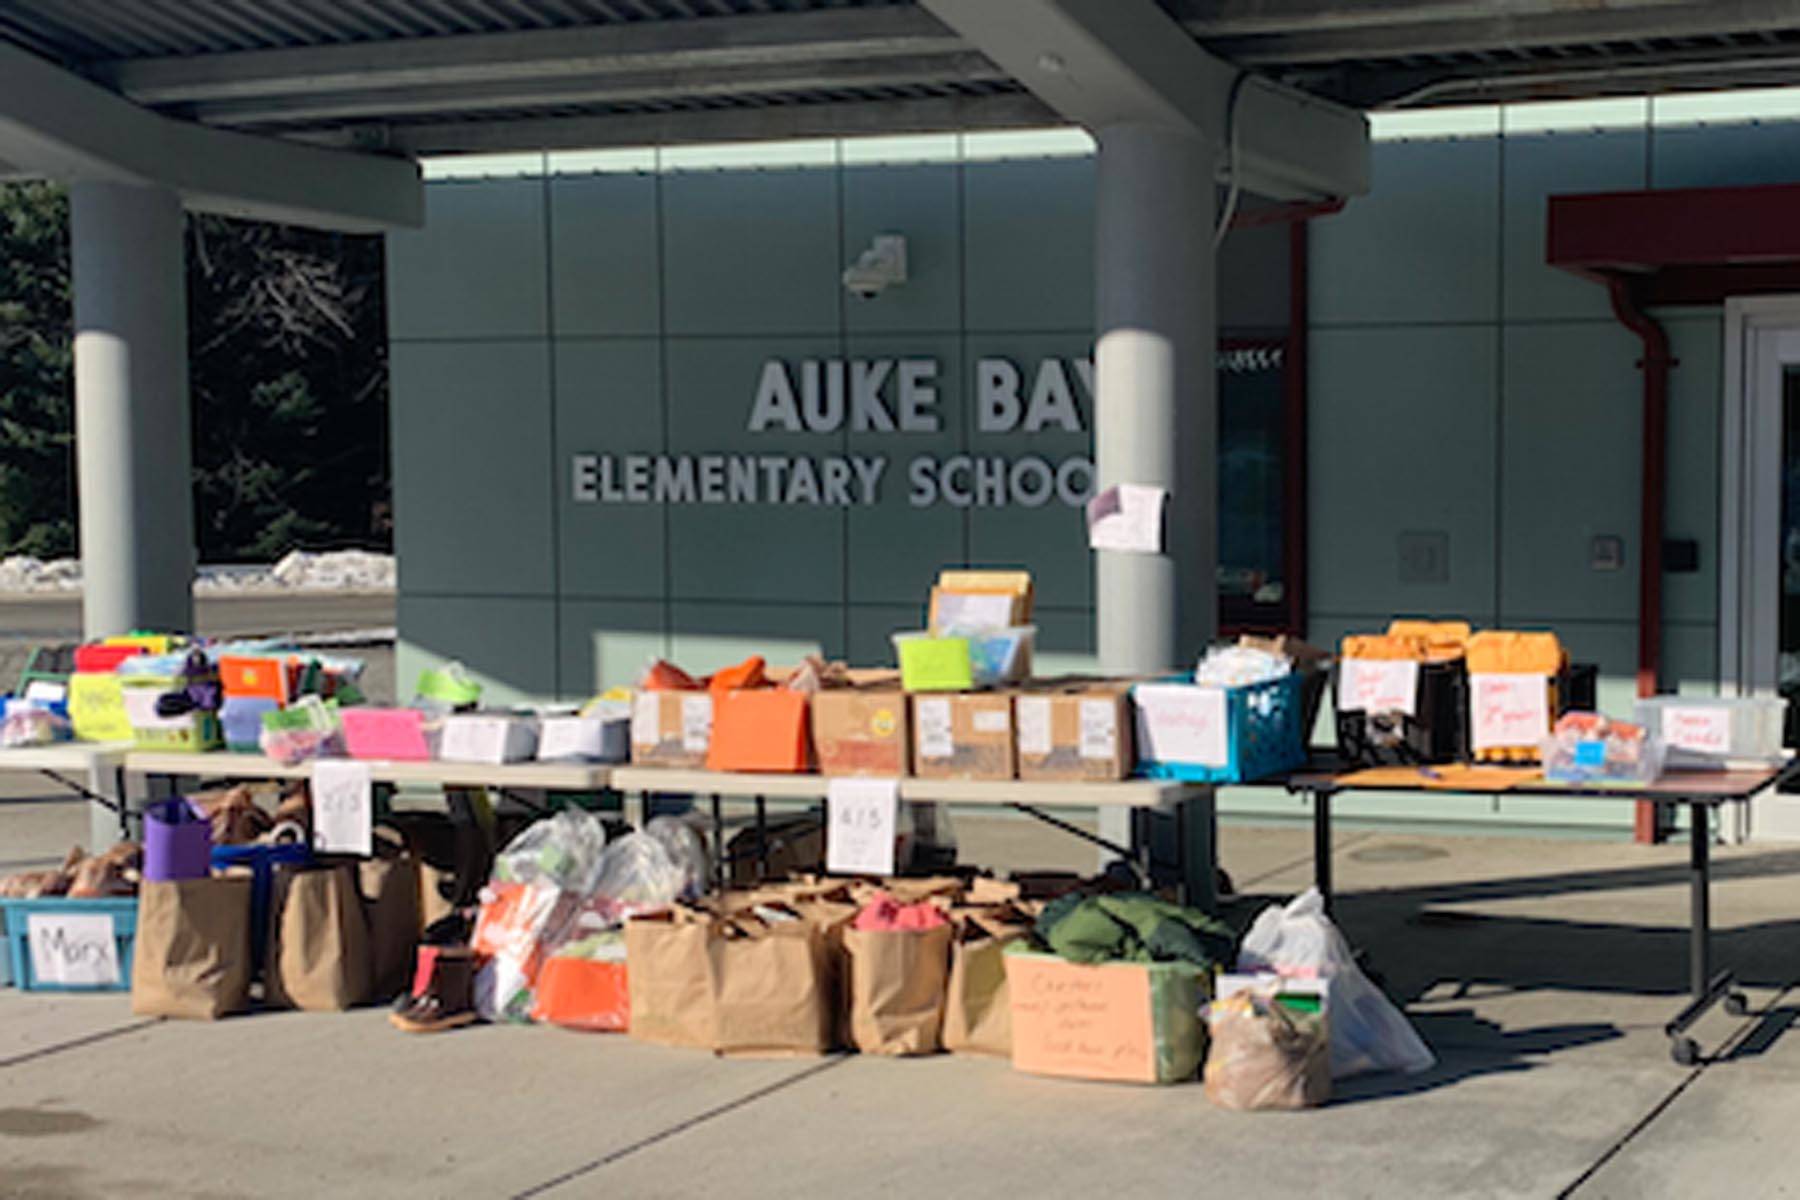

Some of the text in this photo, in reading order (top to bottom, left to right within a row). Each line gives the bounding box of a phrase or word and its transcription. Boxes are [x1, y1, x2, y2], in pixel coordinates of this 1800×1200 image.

[748, 360, 938, 432] AUKE
[572, 455, 1096, 508] ELEMENTARY SCHOO
